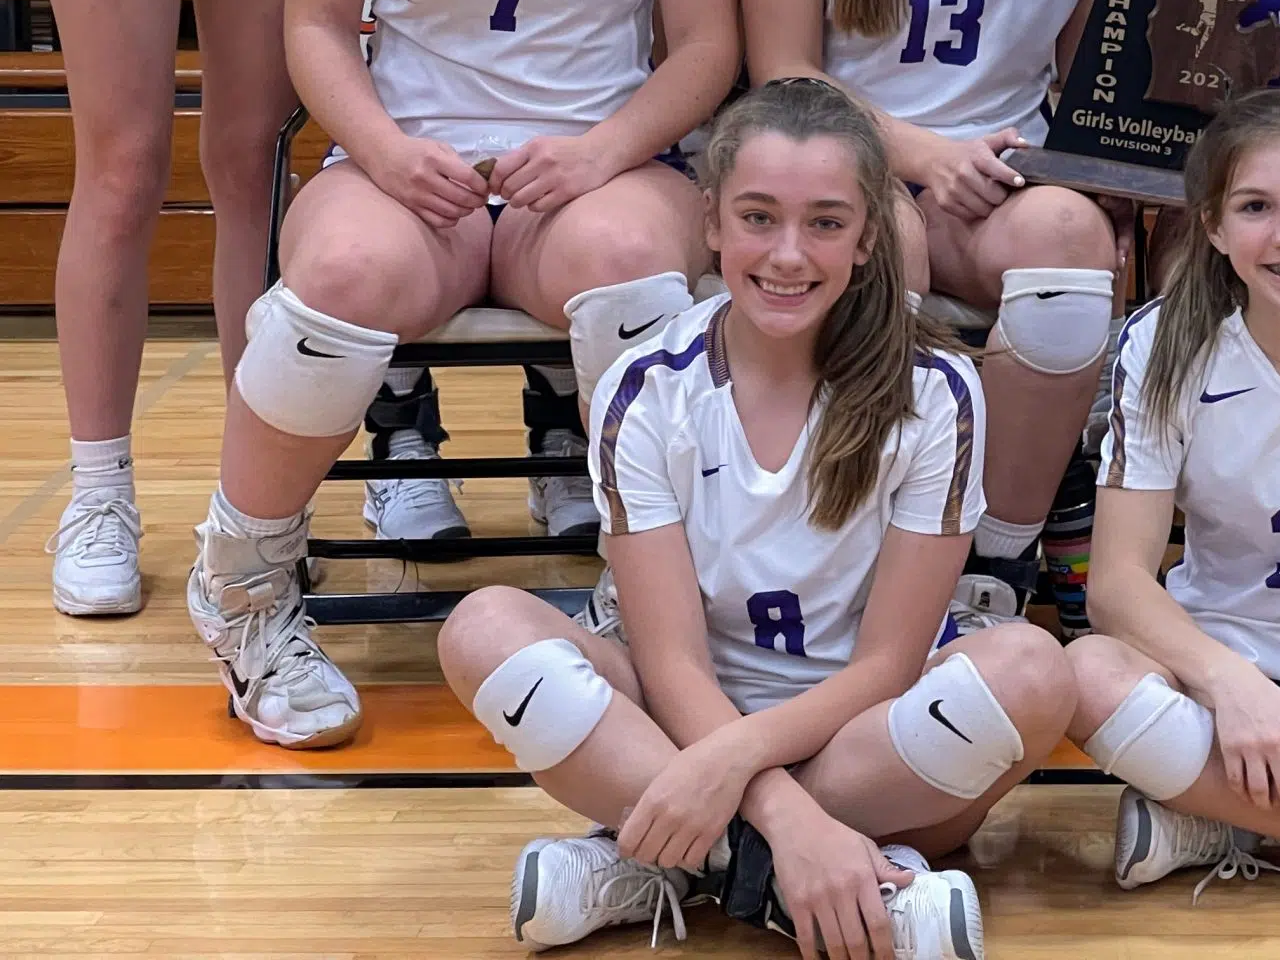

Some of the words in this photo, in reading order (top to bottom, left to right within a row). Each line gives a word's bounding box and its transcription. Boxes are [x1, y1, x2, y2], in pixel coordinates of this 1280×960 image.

[1072, 109, 1114, 131] Girls
[1100, 135, 1161, 153] DIVISION
[1164, 146, 1172, 156] 3
